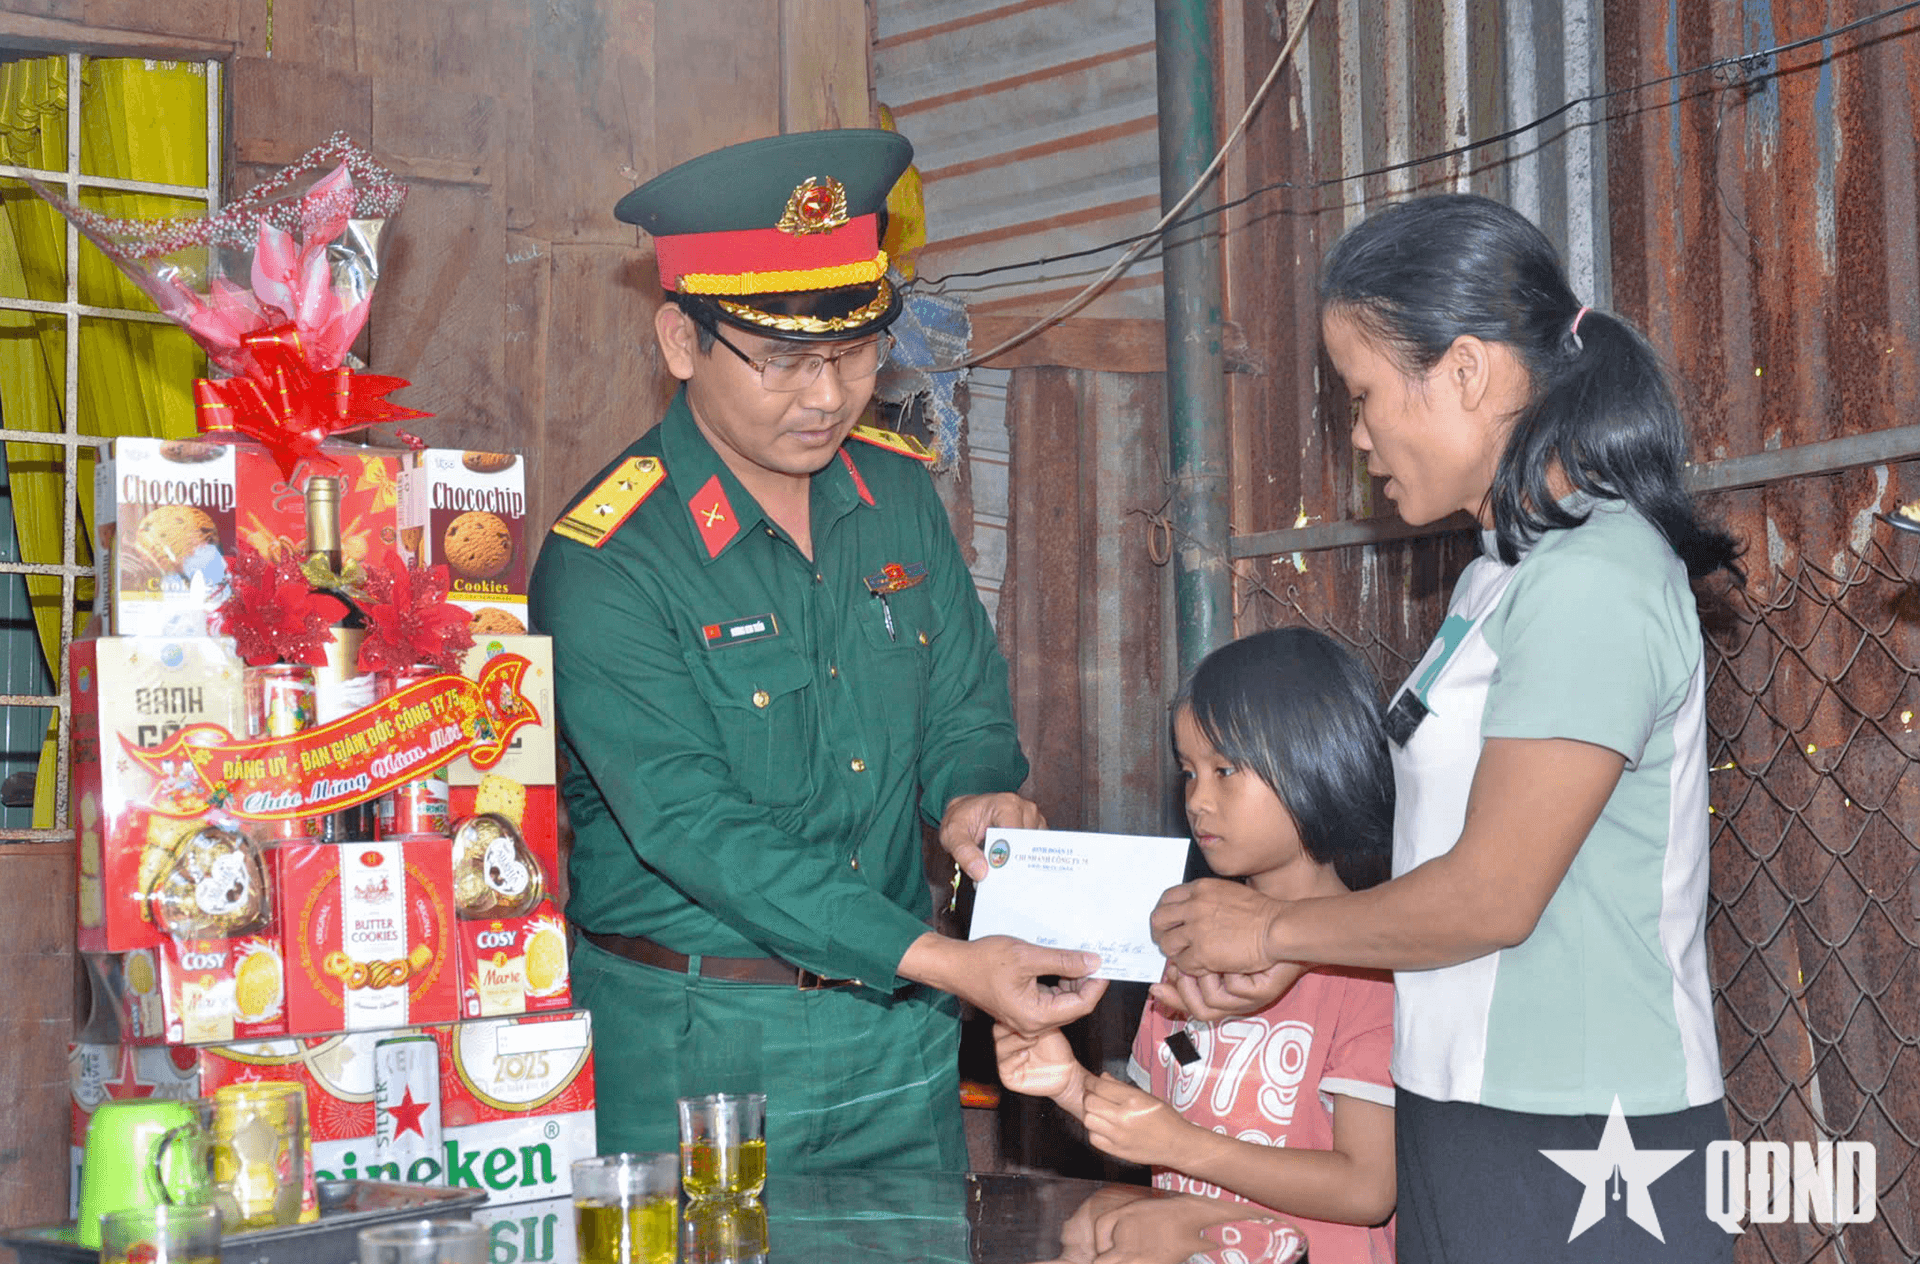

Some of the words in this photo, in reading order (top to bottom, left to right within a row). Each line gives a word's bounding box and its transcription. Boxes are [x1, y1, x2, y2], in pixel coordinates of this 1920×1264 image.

[122, 474, 234, 513] Chocochip
[432, 481, 524, 519] Chocochip
[453, 578, 509, 594] Cookies
[222, 753, 267, 781] ĐẢNG
[300, 743, 332, 773] BAN
[330, 727, 370, 763] GIÁM
[366, 715, 397, 748] ĐỐC
[395, 700, 433, 733] CÔNG
[429, 690, 449, 717] TY
[445, 688, 461, 708] 75
[243, 792, 303, 813] Chúc
[305, 773, 370, 803] Mừng
[371, 745, 427, 778] Năm
[427, 723, 463, 753] Mới
[314, 904, 331, 944] ORIGINAL
[351, 930, 398, 943] COOKIES
[354, 918, 394, 930] BUTTER
[415, 899, 432, 938] ORIGINAL
[476, 930, 517, 950] COSY
[180, 952, 228, 972] COSY
[483, 968, 520, 986] Marie
[493, 1050, 550, 1084] 2025
[375, 1079, 390, 1149] SILVER
[315, 1139, 557, 1190] ineken
